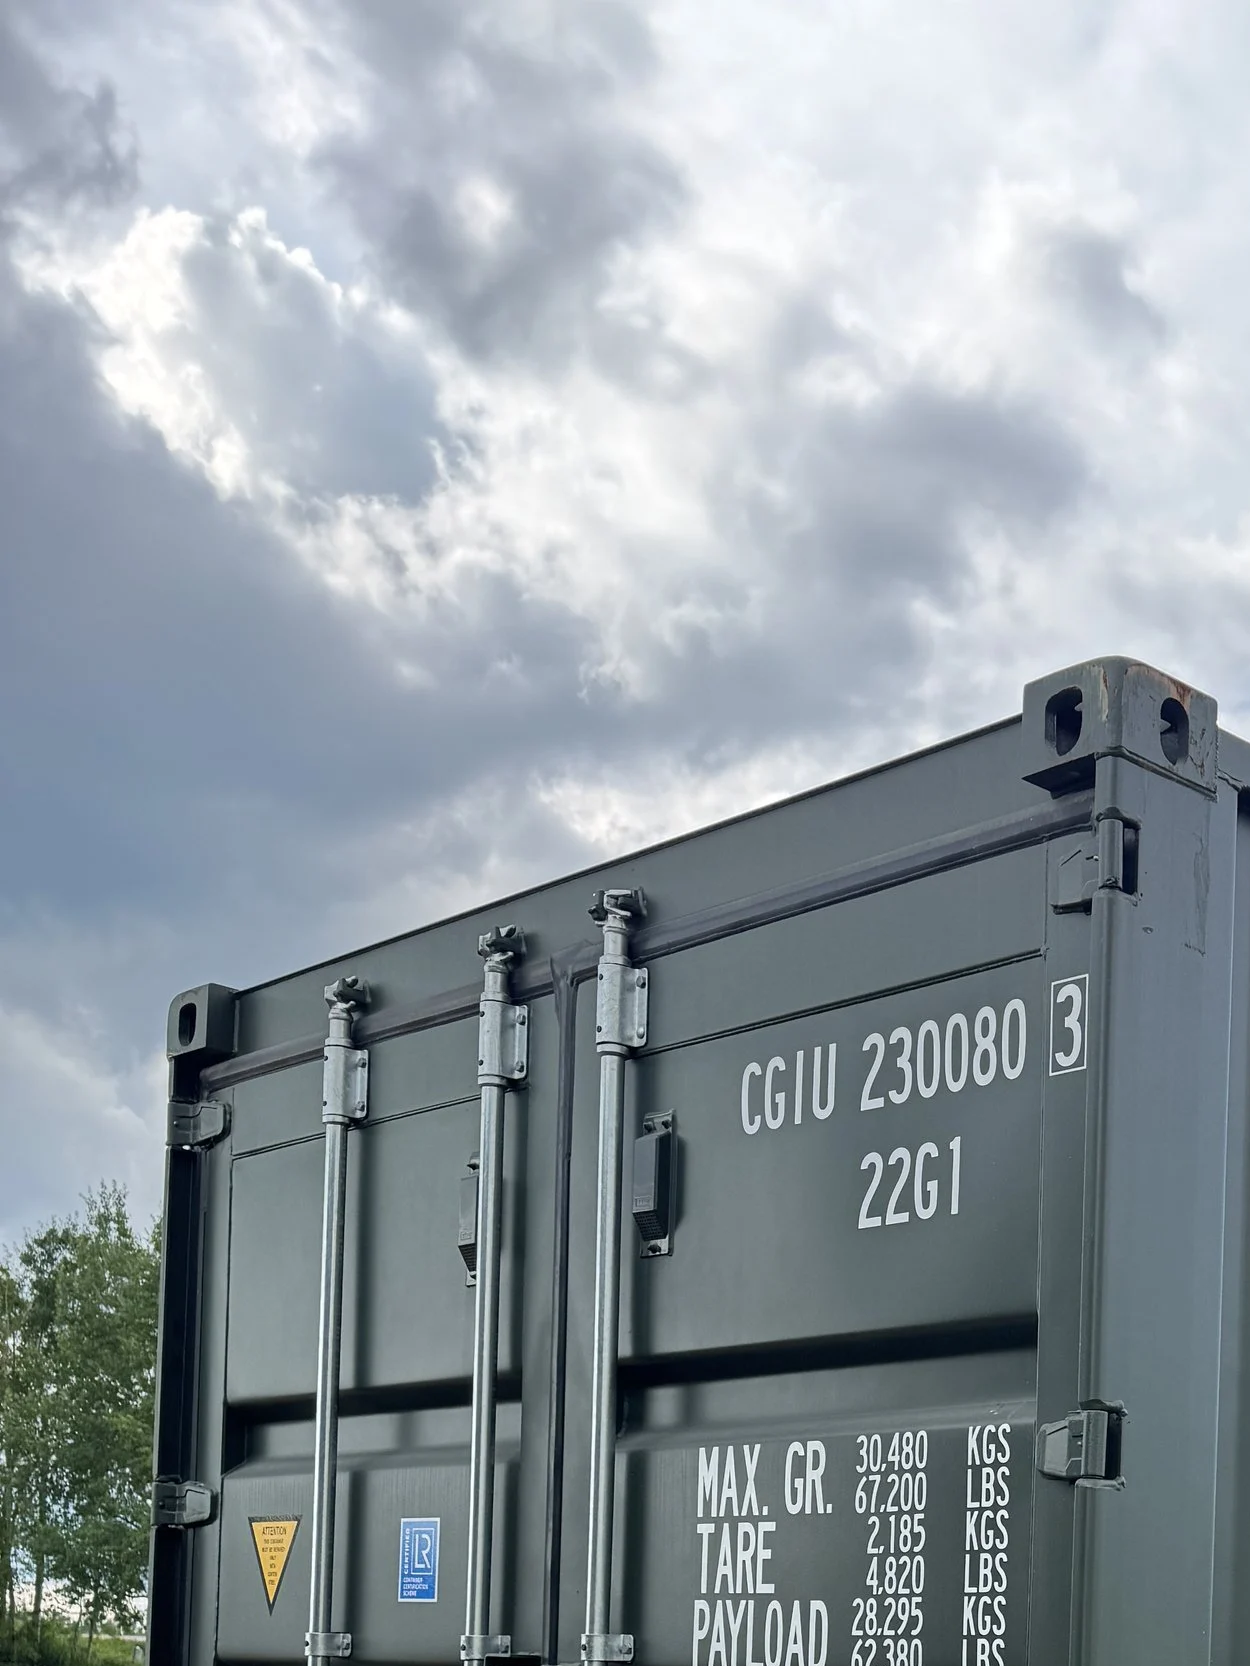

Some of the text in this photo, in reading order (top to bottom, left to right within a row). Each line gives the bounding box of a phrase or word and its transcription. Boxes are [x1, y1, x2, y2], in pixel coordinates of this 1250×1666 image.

[741, 983, 1083, 1135] CGIU 230080 3
[857, 1136, 962, 1230] 22G1
[696, 1423, 1011, 1518] MAX. GR. 30,480 KGS
[854, 1466, 1010, 1514] 67,200 LBS
[262, 1526, 287, 1536] ATTENTION
[414, 1533, 431, 1569] LR
[696, 1509, 1009, 1594] TARE 2,185 KGS
[865, 1552, 1008, 1595] 4,820 LBS
[851, 1596, 924, 1636] 28,295
[962, 1595, 1007, 1636] KGS
